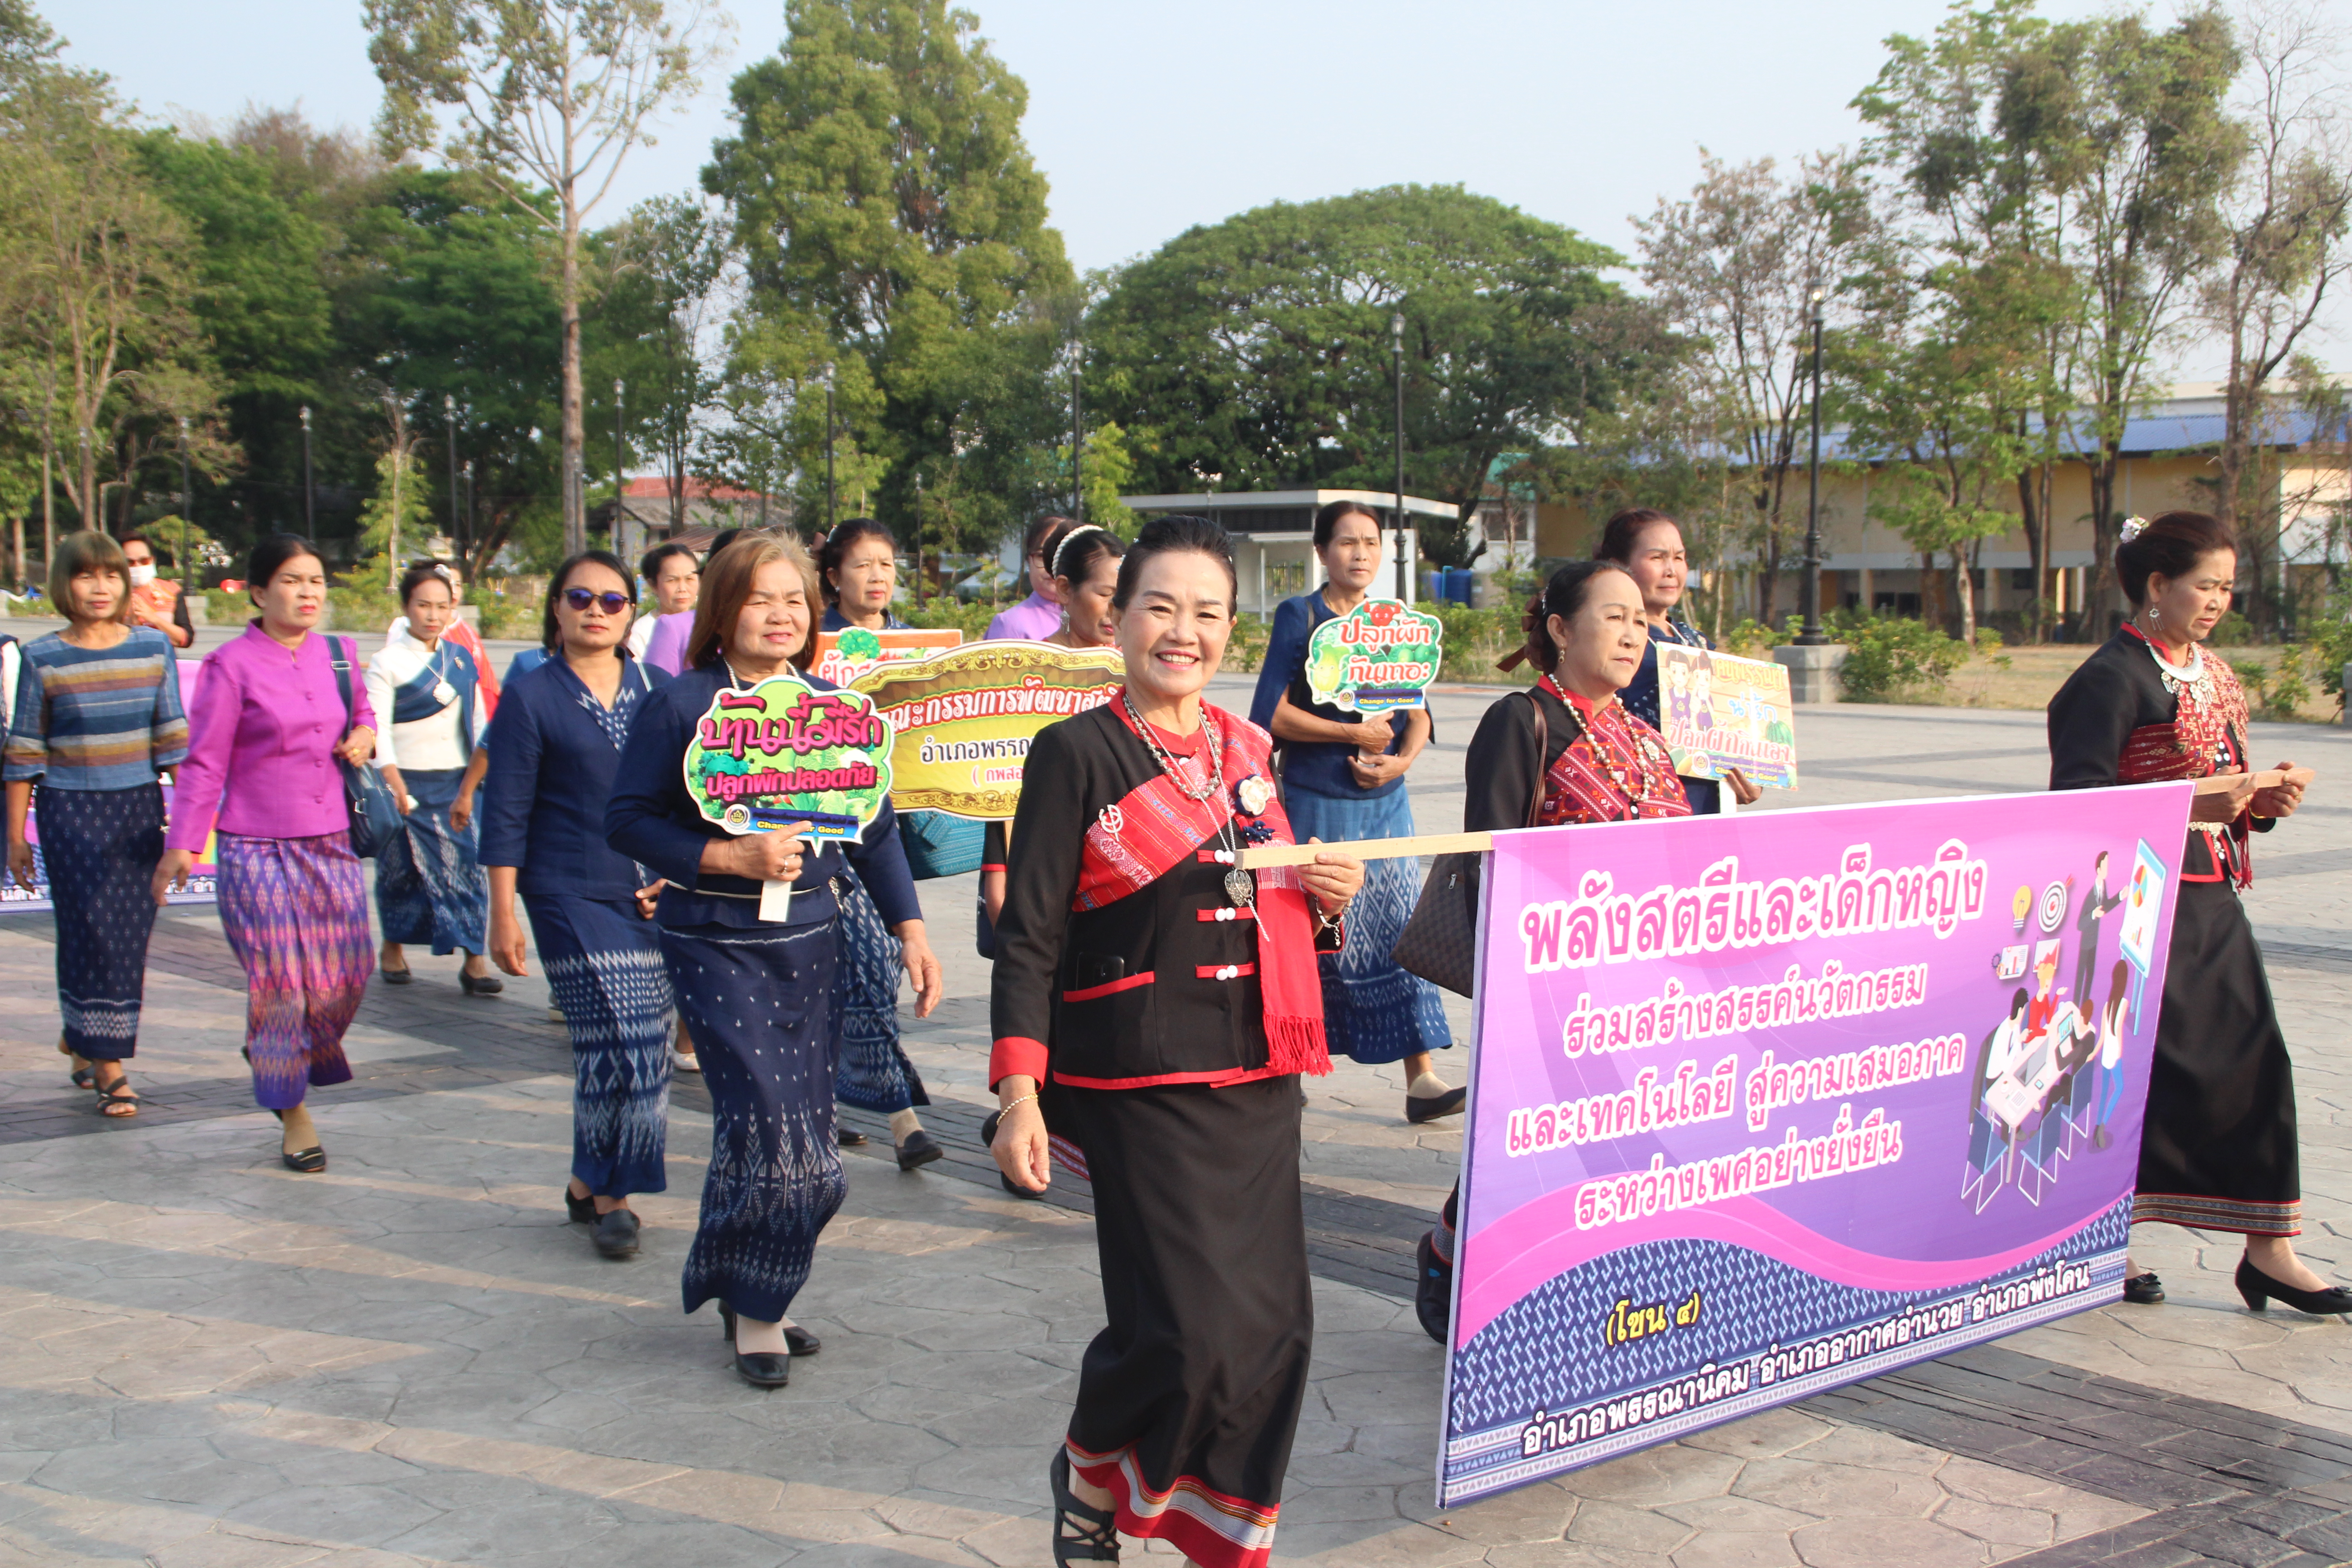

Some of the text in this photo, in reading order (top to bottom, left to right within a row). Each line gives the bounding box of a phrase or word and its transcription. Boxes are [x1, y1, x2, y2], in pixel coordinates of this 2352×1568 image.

[1340, 618, 1430, 651] ปลูกผัก
[1349, 657, 1428, 683] กันเถอะ
[701, 693, 882, 759] บ้านนี้มีรัก
[706, 761, 877, 802] ปลูกผักปลอดภัย
[1758, 773, 1778, 782] Good
[818, 826, 844, 835] Good
[1524, 845, 1984, 965] พลังสตรีและเด็กหญิง
[1567, 963, 1925, 1054] ร่วมสร้างสรรค์นวัตกรรม
[1510, 1036, 1965, 1153] และเทคโนโลยี สู่ความเสมอภาค
[1578, 1106, 1901, 1226] ระหว่างเพศอย่างยั่งยืน
[1606, 1299, 1667, 1346] (โซน
[1522, 1260, 2090, 1455] อำเภอพรรณานิคม อำเภออากาศอำนวย อำเภอพังโคน
